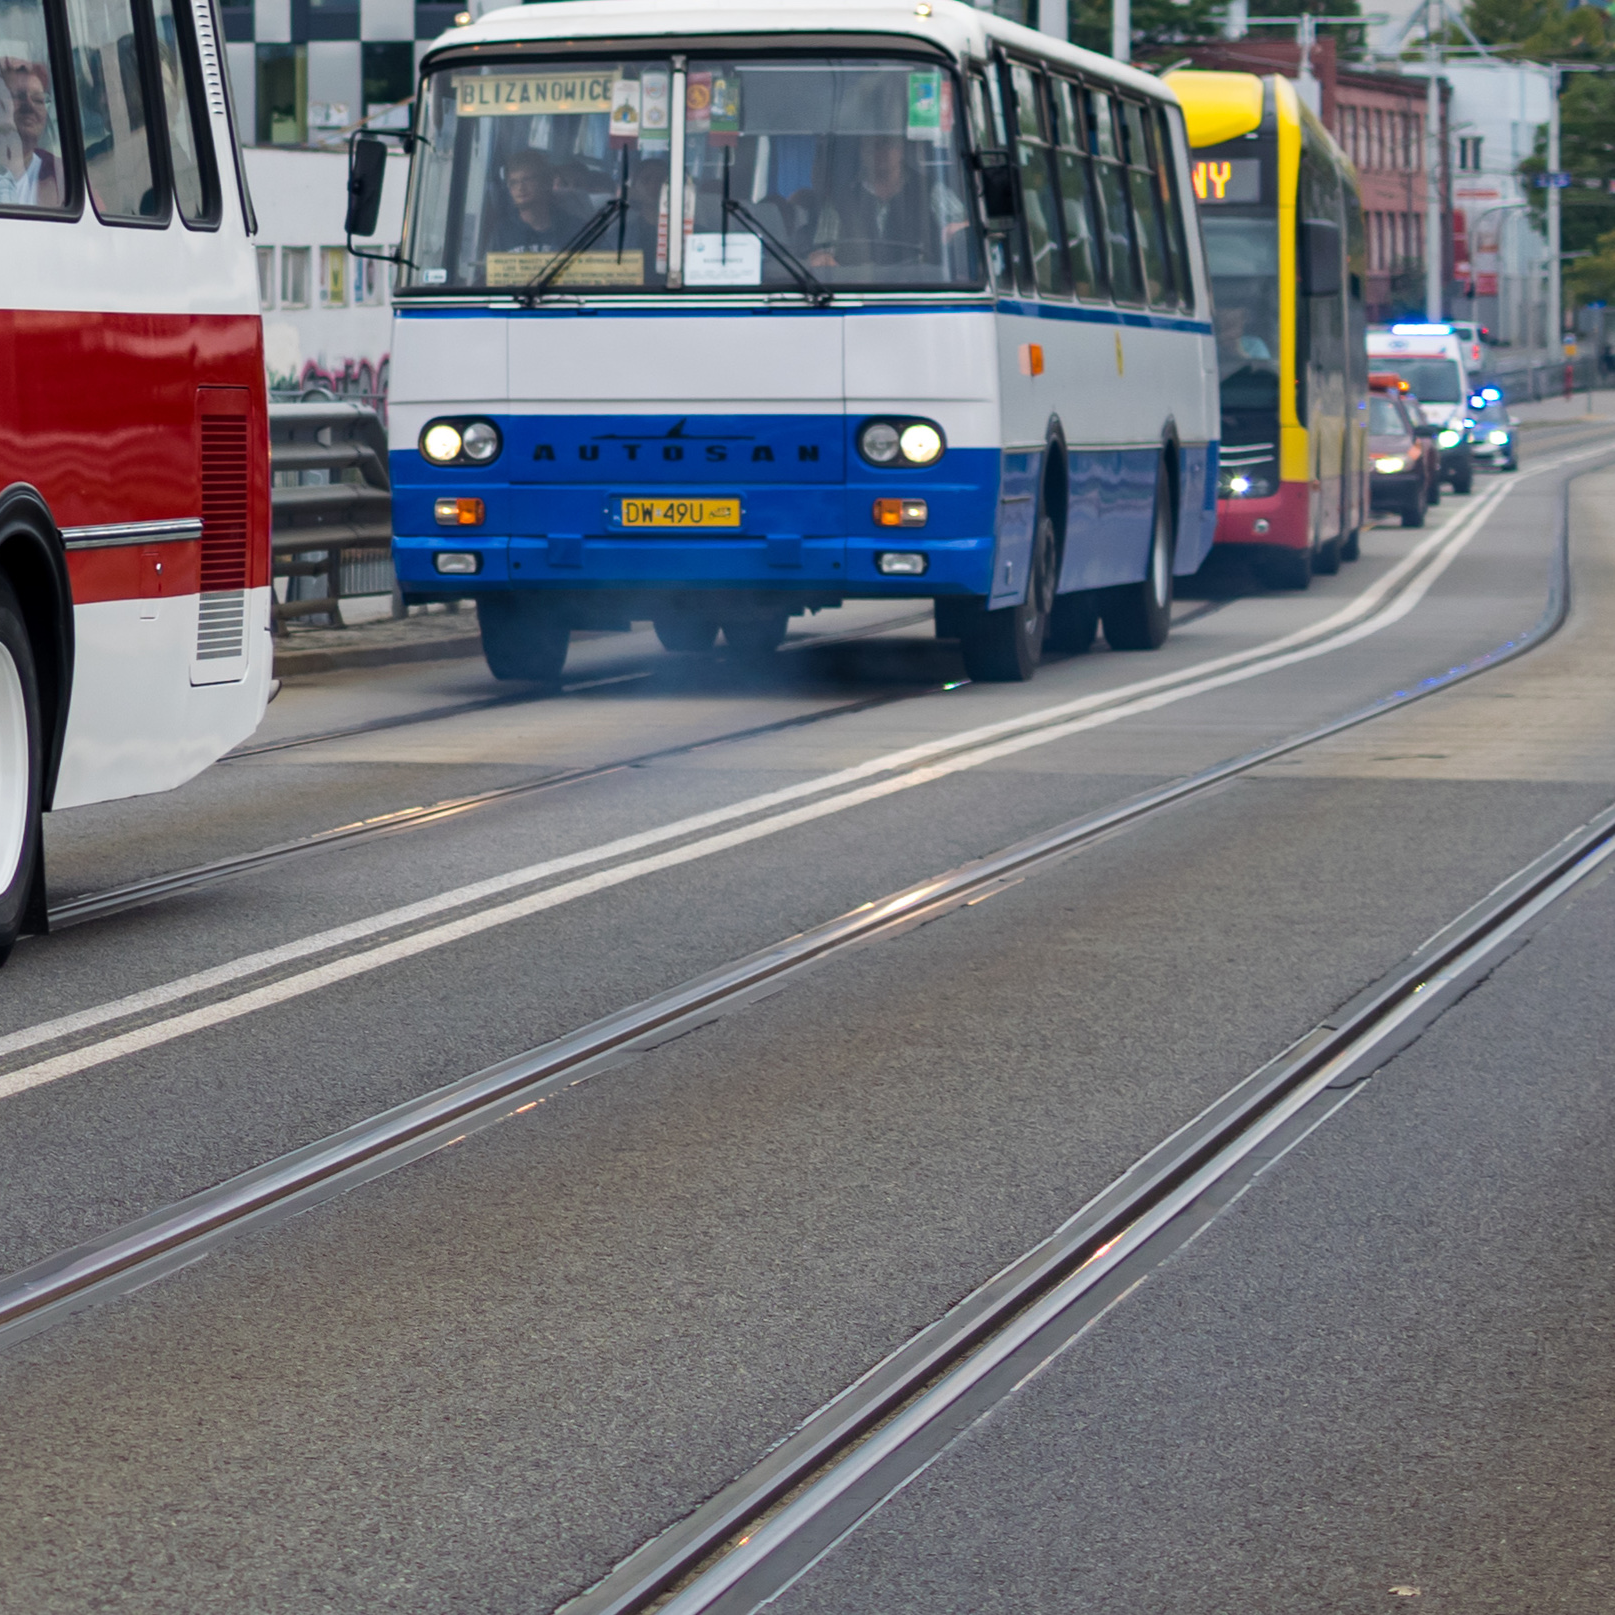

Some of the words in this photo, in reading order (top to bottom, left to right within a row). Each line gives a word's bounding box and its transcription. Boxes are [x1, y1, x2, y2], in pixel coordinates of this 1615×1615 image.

[532, 444, 820, 462] AUTOSAN
[625, 502, 655, 524] DW
[662, 502, 704, 524] 49U
